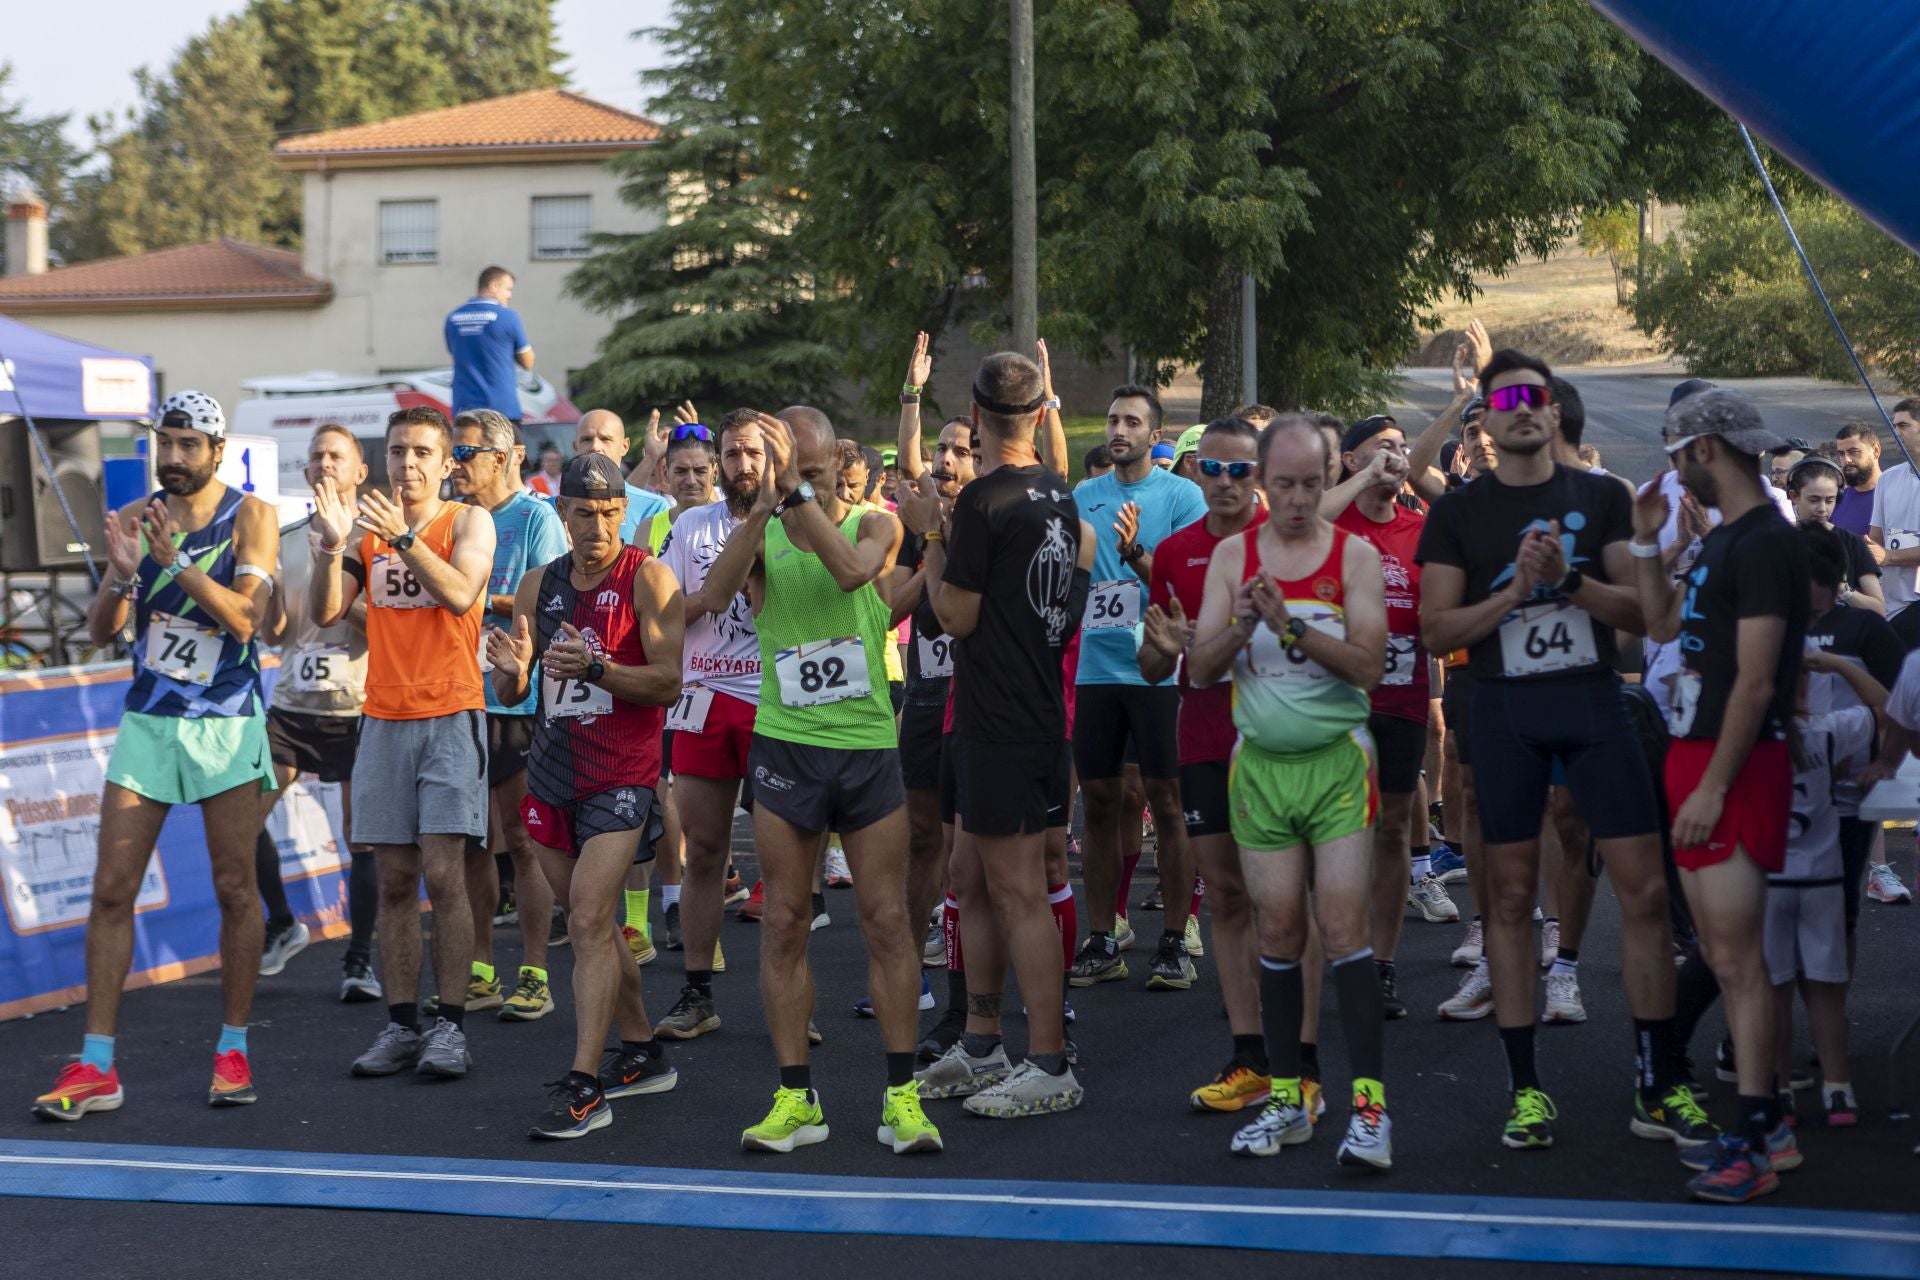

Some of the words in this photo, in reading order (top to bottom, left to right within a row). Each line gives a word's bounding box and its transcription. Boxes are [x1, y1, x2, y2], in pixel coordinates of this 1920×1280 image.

[386, 569, 421, 597] 58
[1093, 593, 1124, 619] 36
[159, 632, 198, 669] 74
[1525, 622, 1575, 659] 64
[300, 657, 330, 680] 65
[800, 656, 849, 693] 82
